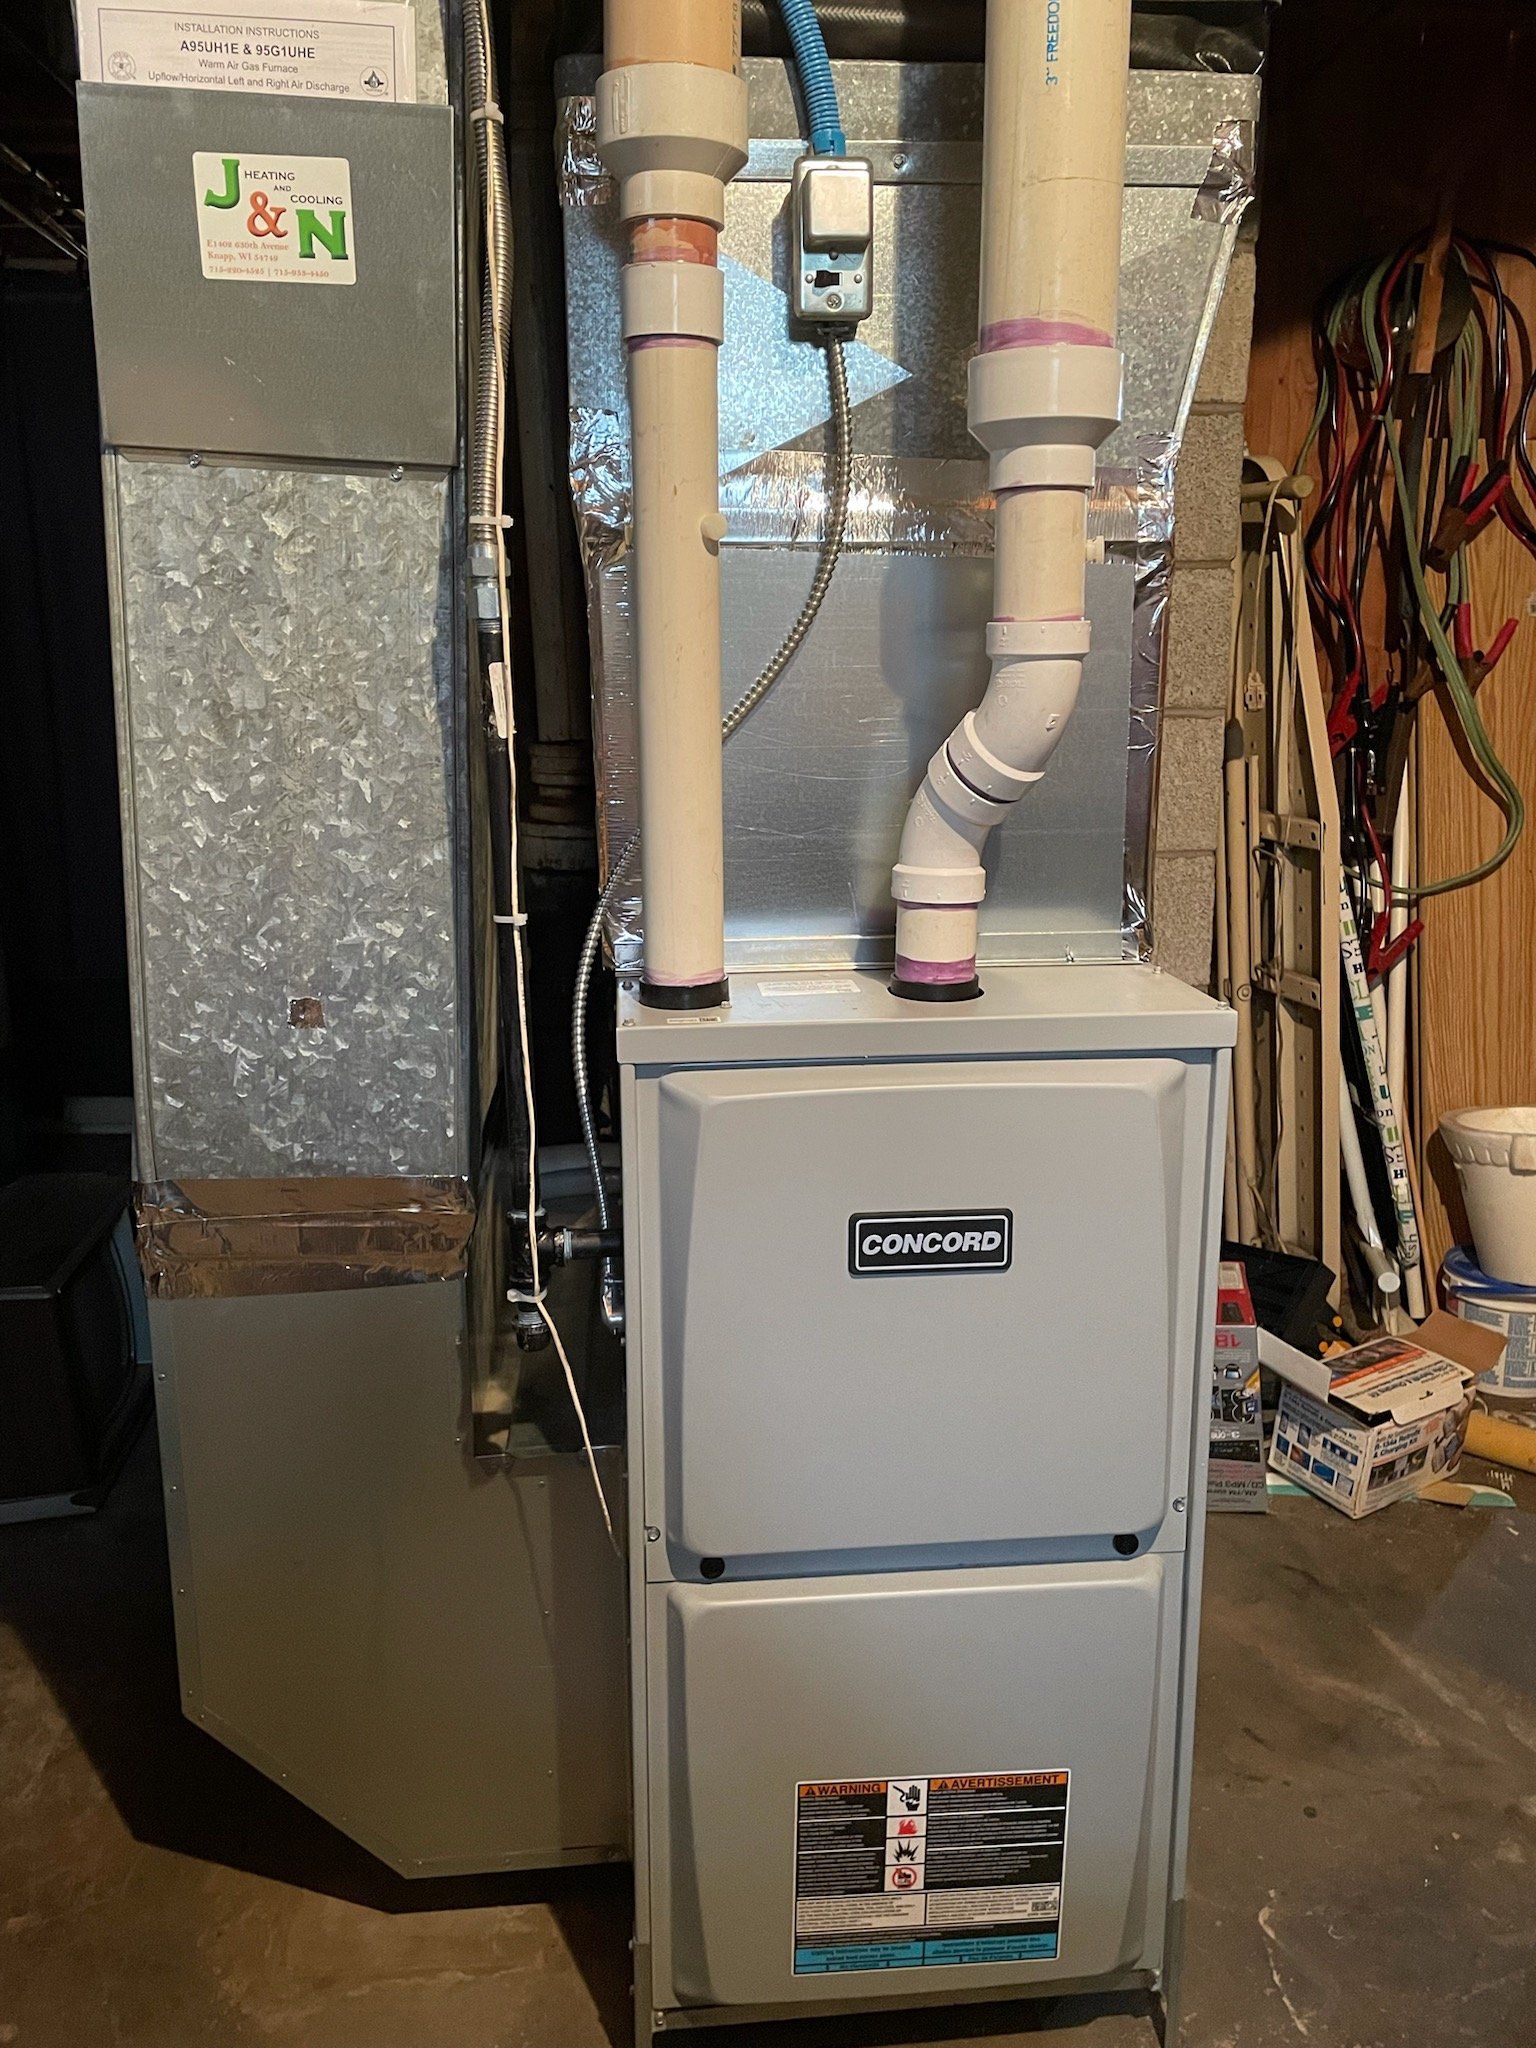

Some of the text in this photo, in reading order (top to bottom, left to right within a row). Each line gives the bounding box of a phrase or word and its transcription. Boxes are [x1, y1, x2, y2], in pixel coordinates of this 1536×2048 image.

[174, 22, 320, 39] INSTALLATION INSTRUCTIONS
[1046, 0, 1060, 62] FREEDO
[180, 40, 316, 59] A95UH1E & 95G1UHE
[198, 58, 299, 74] Warm Air Gas Furnace
[148, 71, 350, 95] Upflow/Horizontal Left and Right Air Discharge
[244, 170, 296, 181] HEATING
[273, 184, 292, 192] AND
[290, 194, 343, 205] COOLING
[204, 158, 349, 260] J & N
[260, 242, 289, 251] Avenue
[861, 1231, 1002, 1256] CONCORD
[817, 1783, 881, 1796] WARNING
[950, 1774, 1060, 1790] AVERTISSEMENT
